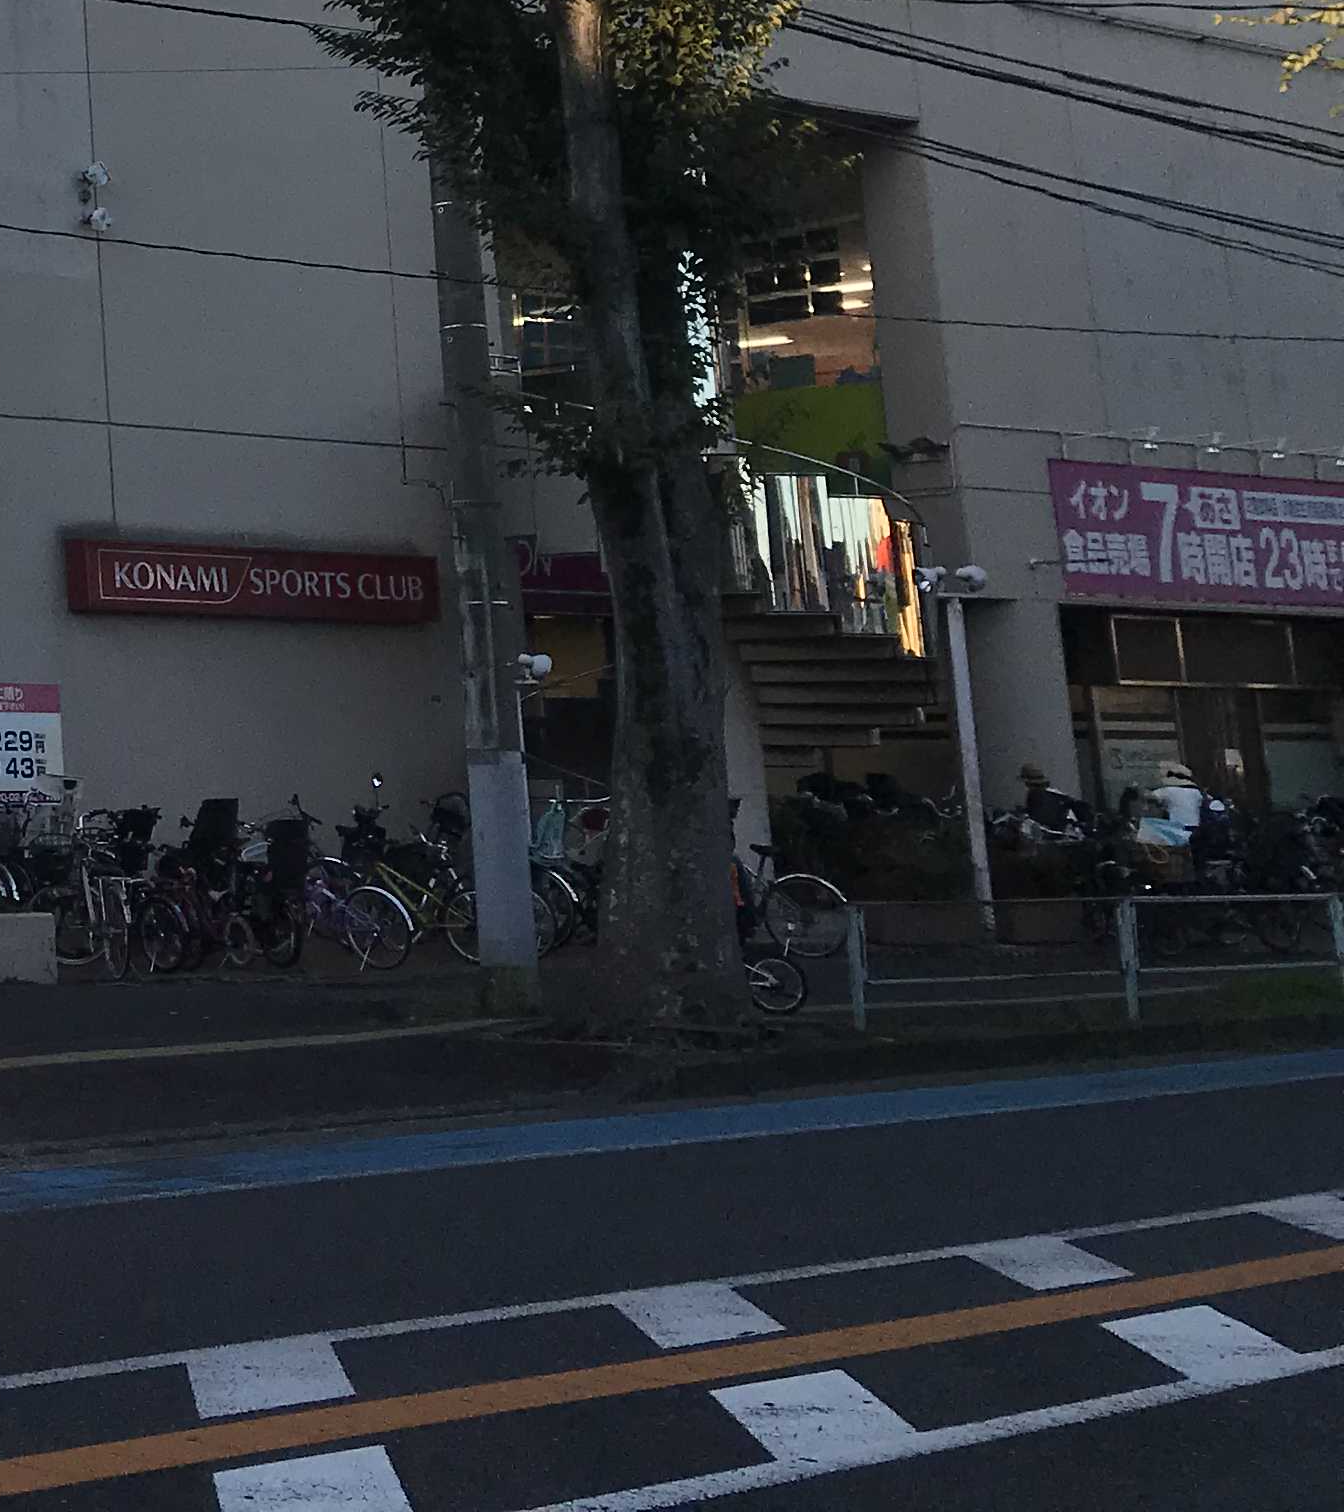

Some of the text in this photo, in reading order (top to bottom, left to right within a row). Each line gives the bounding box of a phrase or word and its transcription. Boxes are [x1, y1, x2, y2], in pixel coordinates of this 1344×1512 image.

[1068, 479, 1129, 521] イオン
[113, 560, 425, 602] KONAMI SPORTS CLUB
